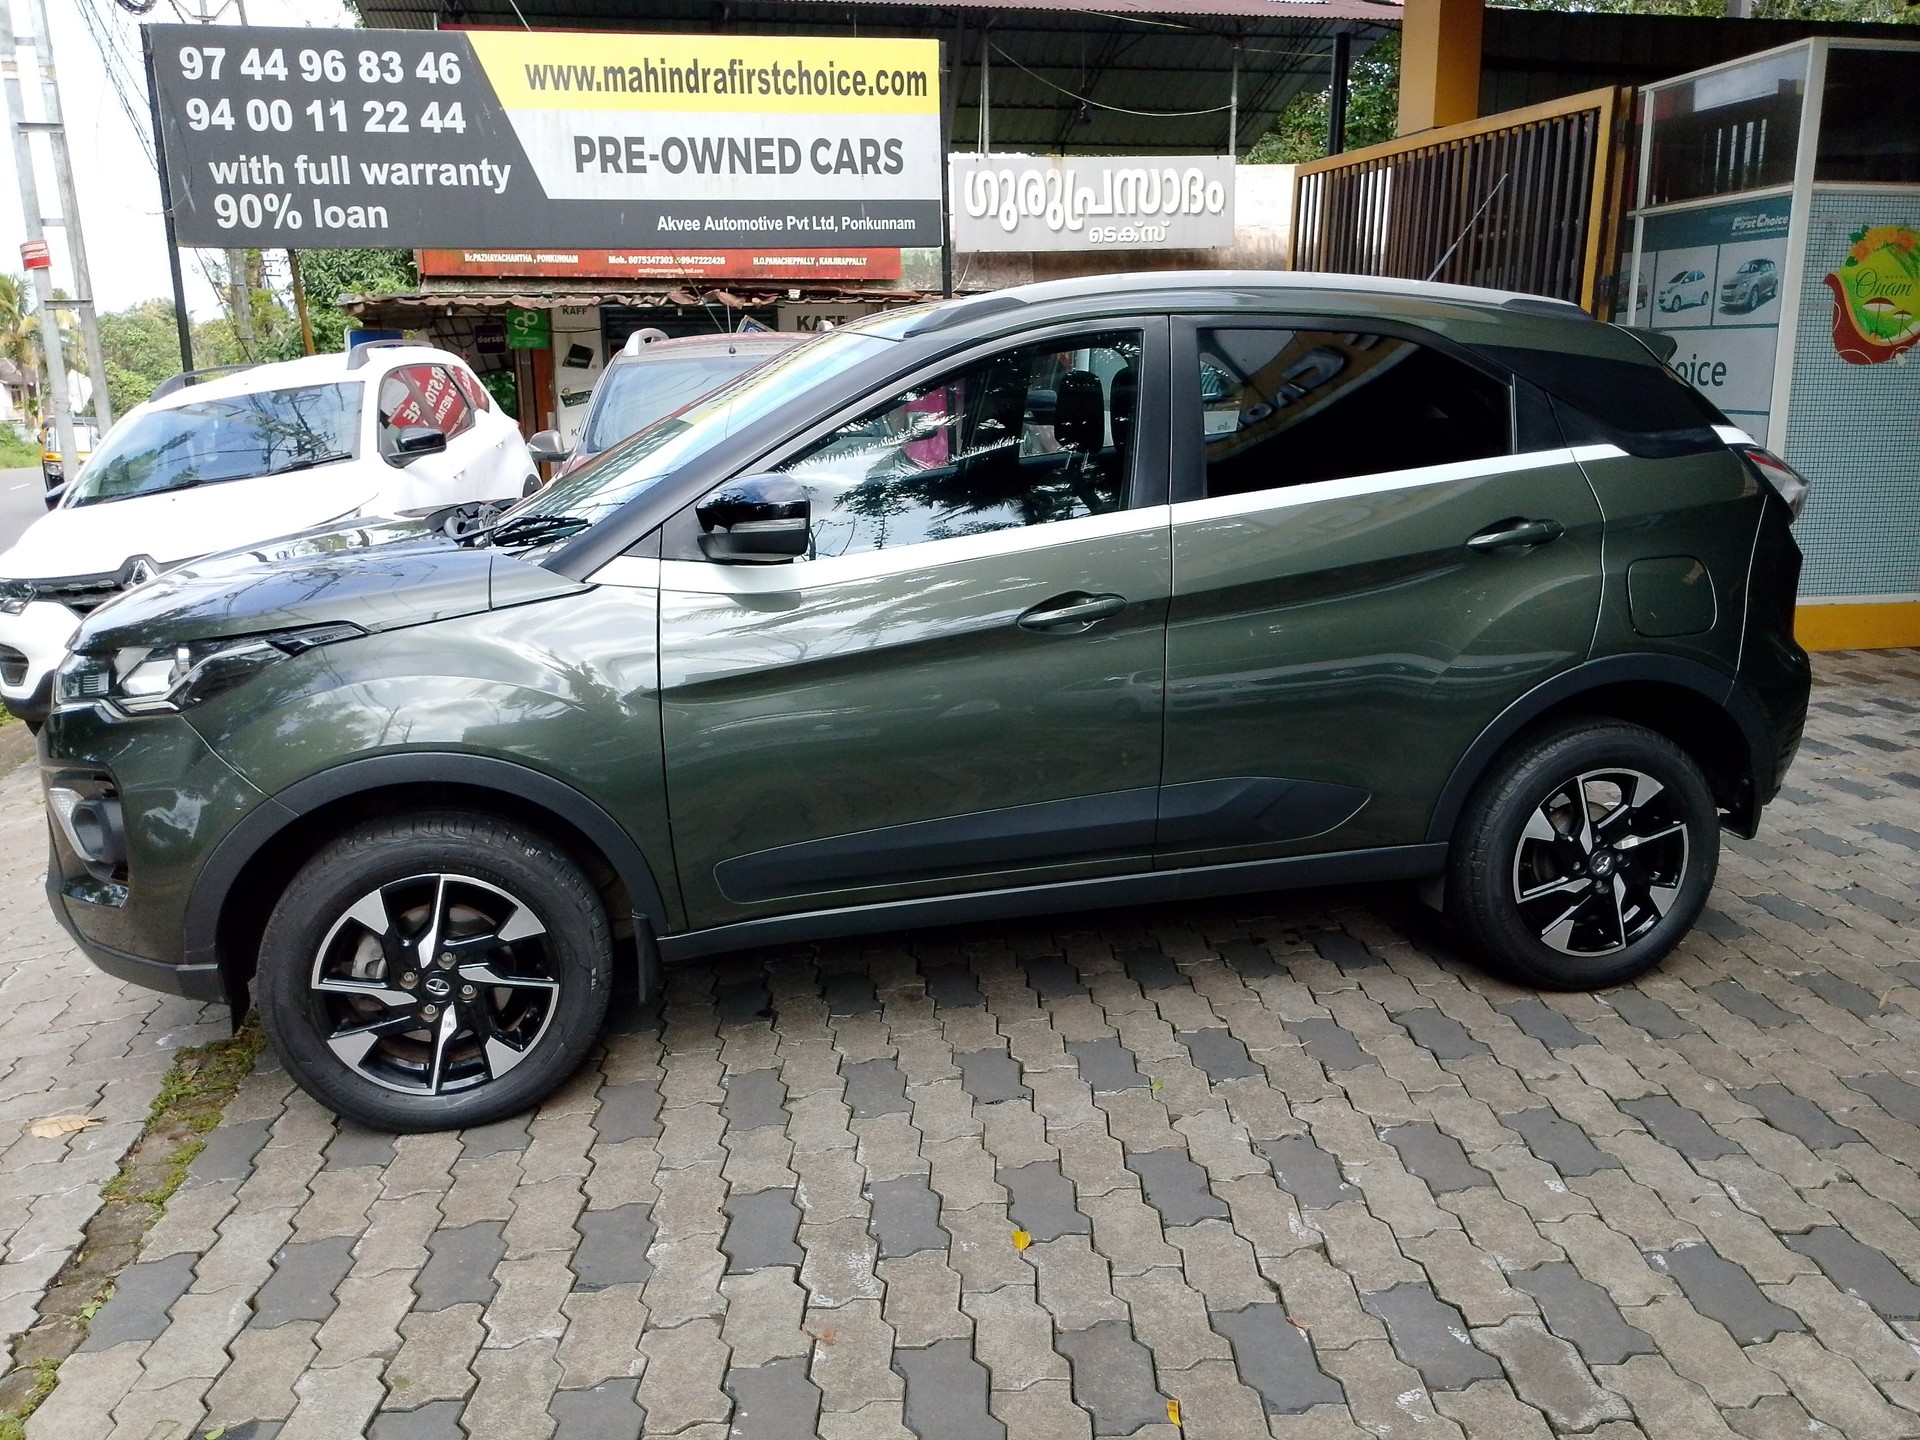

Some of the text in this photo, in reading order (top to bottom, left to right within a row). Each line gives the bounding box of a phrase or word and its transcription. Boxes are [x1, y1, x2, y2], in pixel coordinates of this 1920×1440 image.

[179, 47, 462, 84] 97 44 96 83 46
[524, 57, 928, 97] www.mahindrafirstchoice.com
[186, 98, 466, 134] 94 00 11 22 44
[574, 136, 904, 174] PRE-OWNED CARS
[209, 155, 512, 194] with full warranty
[214, 193, 389, 229] 90% loan
[657, 215, 916, 233] Akvee Automotive Pvt Ltd, Ponkunnam
[608, 255, 627, 264] Mob.
[1856, 267, 1912, 298] Onam
[562, 307, 588, 316] KAFF
[1673, 353, 1727, 387] oice
